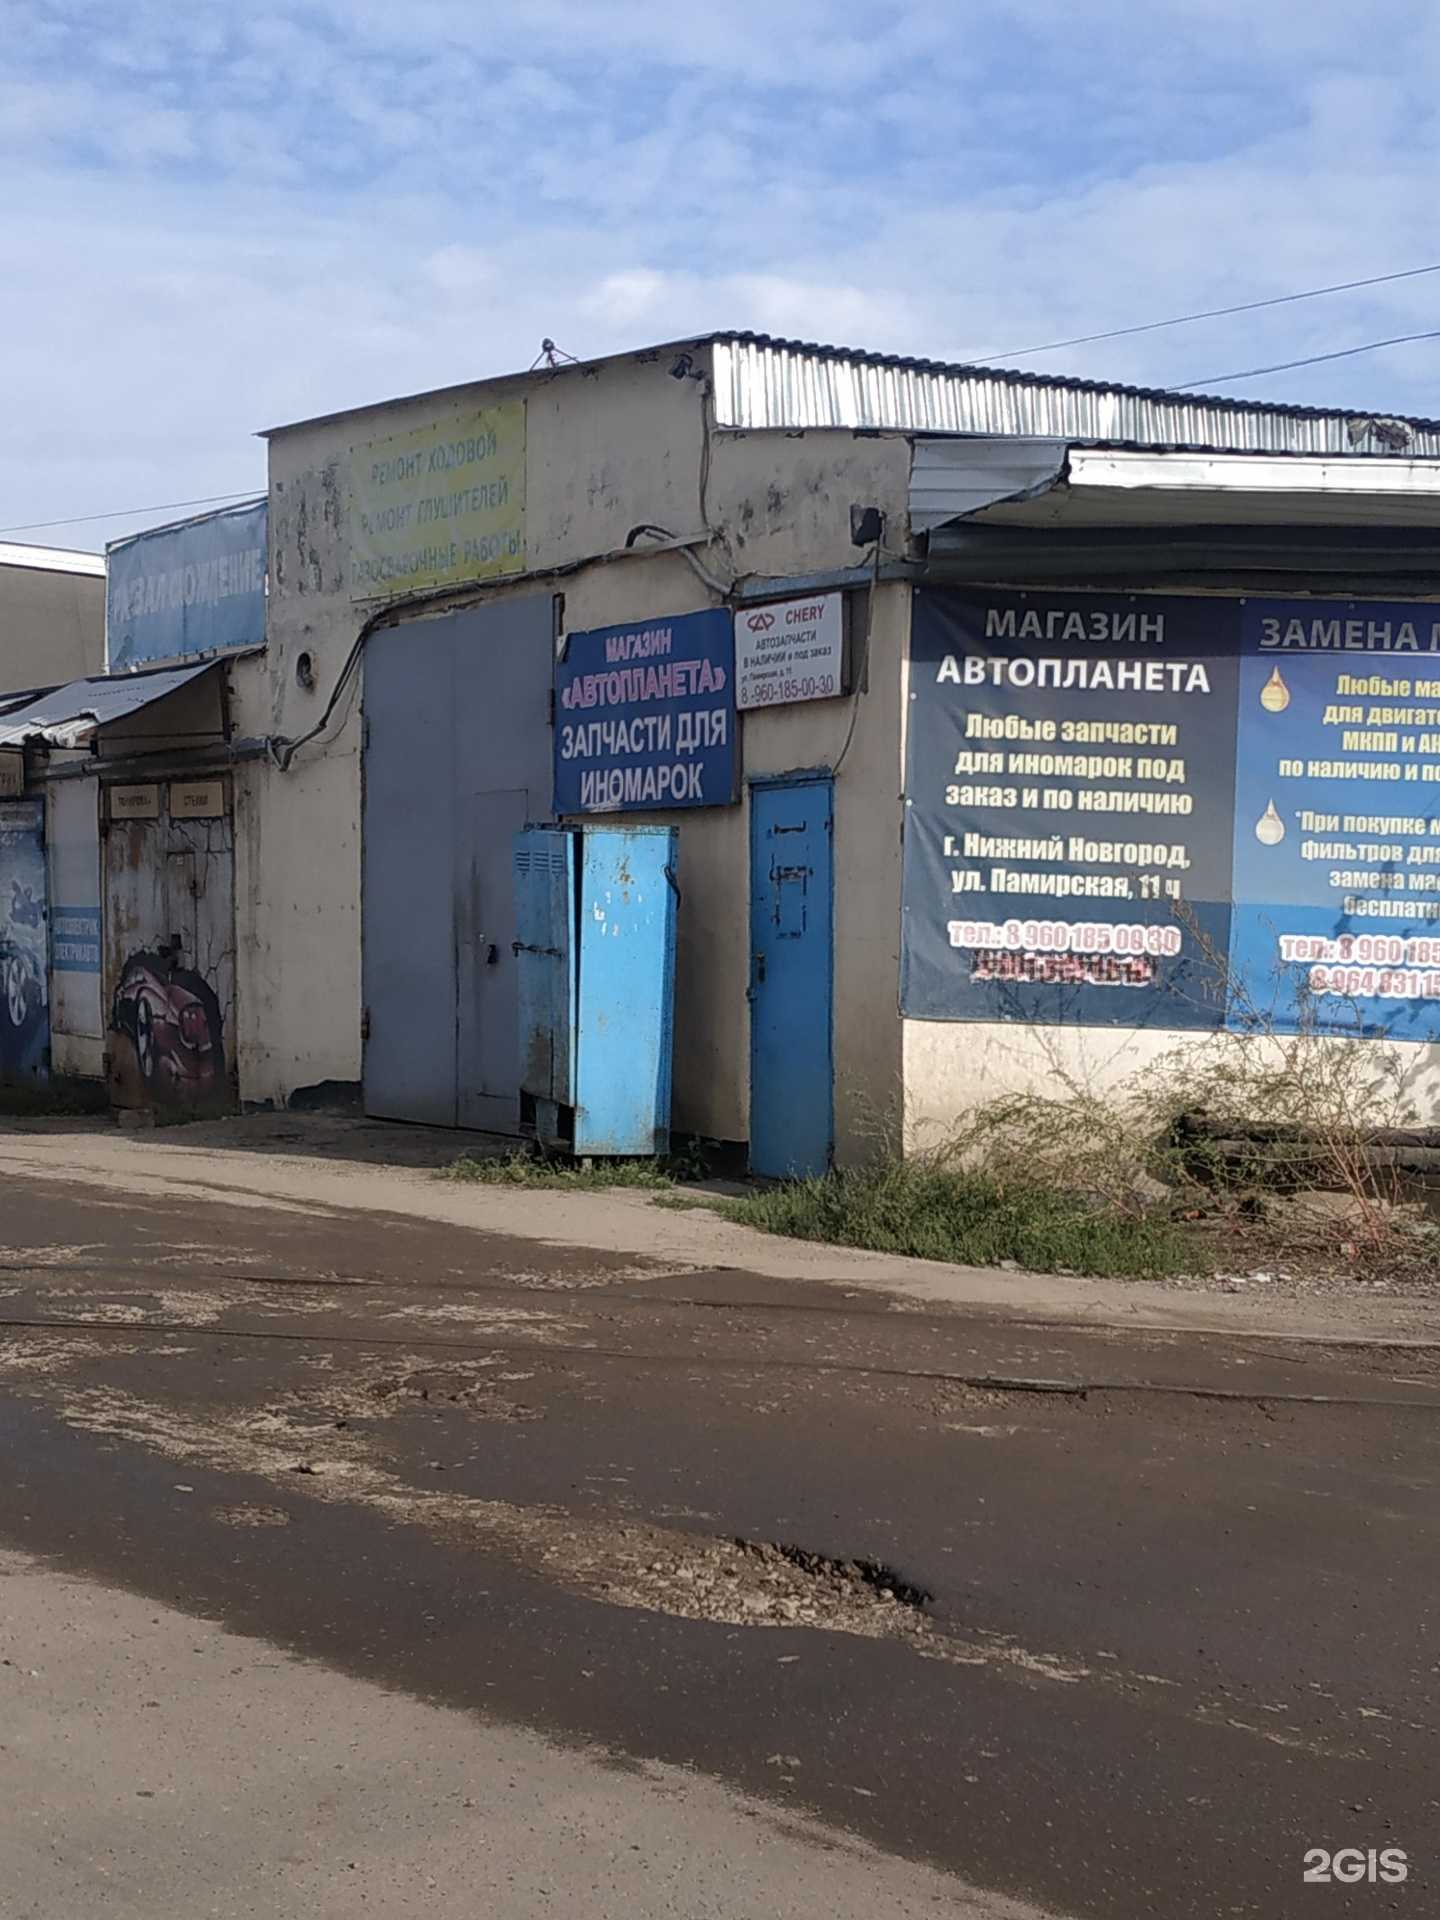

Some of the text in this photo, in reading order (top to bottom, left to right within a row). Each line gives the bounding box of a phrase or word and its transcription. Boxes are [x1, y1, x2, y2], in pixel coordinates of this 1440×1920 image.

[372, 452, 422, 485] РЕМОНТ
[785, 604, 825, 625] CHERY
[984, 608, 1165, 643] МАГАЗИН
[605, 628, 672, 662] МАГАЗИН
[755, 629, 817, 650] АВТОЗАПЧАСТИ
[1259, 618, 1419, 650] ЗАМЕНА
[750, 651, 786, 667] НАЛИЧИИ
[561, 658, 726, 709] «АВТОПЛАНЕТА»
[936, 654, 1211, 693] АВТОПЛАНЕТА
[1336, 674, 1411, 697] Любые
[965, 712, 1178, 746] Любые запчасти
[1322, 705, 1364, 726] для
[561, 708, 727, 759] ЗАПЧАСТИ ДЛЯ
[1342, 731, 1398, 752] МКПП
[1402, 735, 1416, 753] и
[955, 752, 1186, 783] для иномарок под
[1279, 760, 1303, 778] по
[1307, 760, 1401, 780] наличию
[1404, 764, 1418, 781] и
[580, 762, 704, 804] ИНОМАРОК
[945, 785, 1193, 815] заказ и по наличию
[1343, 814, 1426, 836] покупке
[943, 832, 1192, 870] г. Нижний Новгород,
[1301, 839, 1404, 862] фильтров
[951, 869, 986, 894] ул.
[990, 868, 1134, 900] Памирская,
[1138, 874, 1160, 899] 11
[1329, 870, 1405, 891] замена
[950, 922, 1001, 945] тел.:
[1006, 923, 1020, 946] 8
[1024, 924, 1068, 948] 960
[1071, 925, 1111, 949] 185
[1339, 937, 1354, 960] 8
[1358, 938, 1403, 962] 960
[1379, 970, 1418, 995] 831
